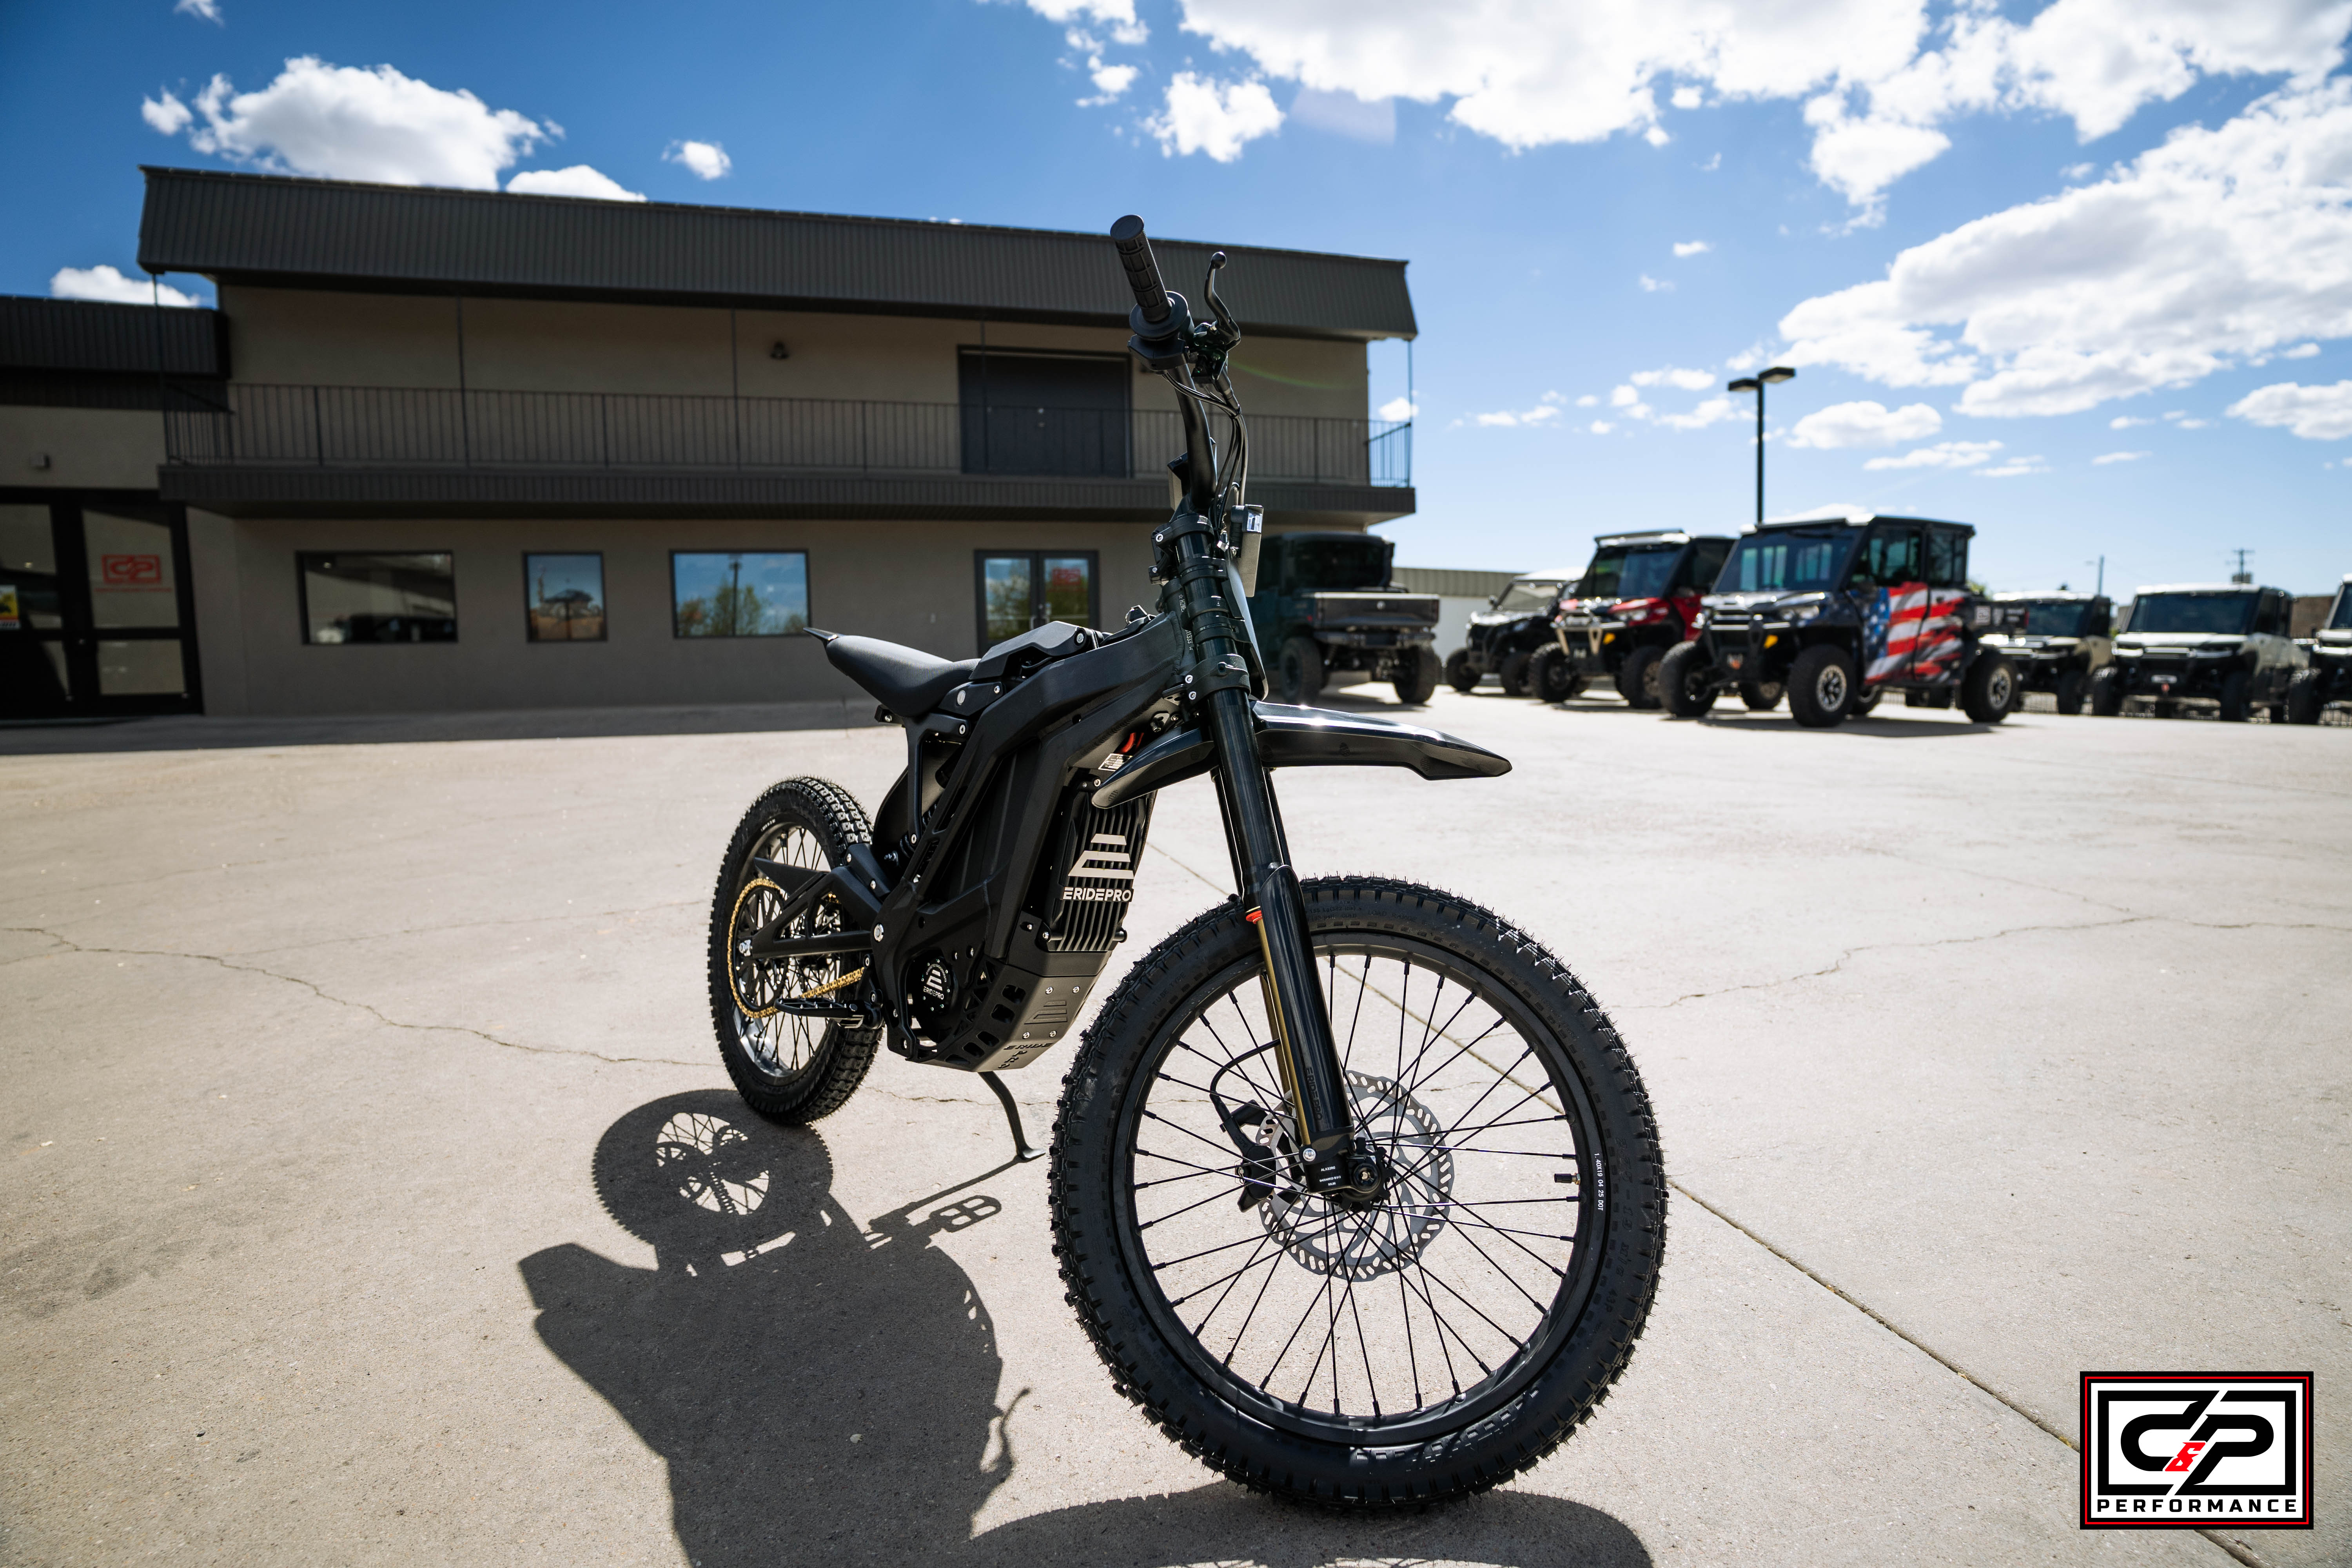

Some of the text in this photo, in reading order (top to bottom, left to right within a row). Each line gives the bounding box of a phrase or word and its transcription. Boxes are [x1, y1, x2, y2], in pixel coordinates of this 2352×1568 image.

[1063, 887, 1132, 901] ERIDEPRO
[923, 986, 944, 999] ERIDEPRO
[1151, 987, 1169, 1007] TUBE
[1305, 1067, 1323, 1121] ERIDEPRO
[1594, 1153, 1603, 1177] 1.40X19
